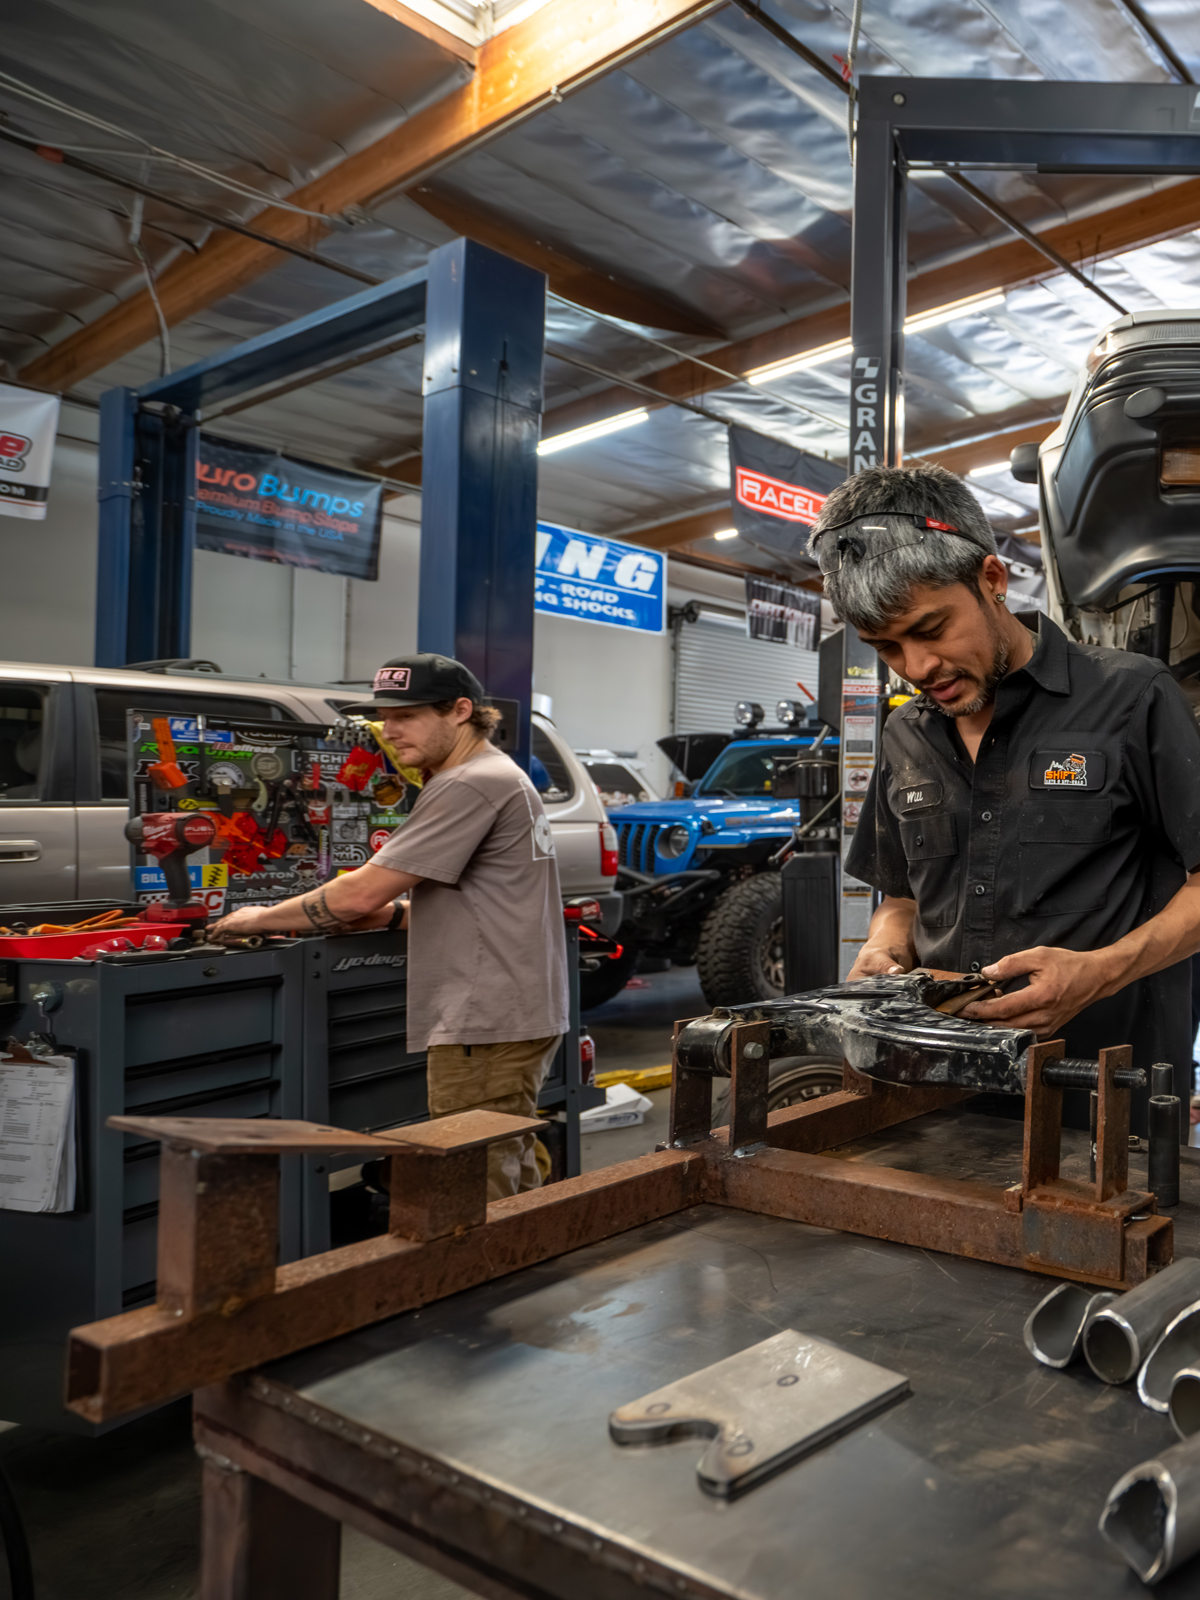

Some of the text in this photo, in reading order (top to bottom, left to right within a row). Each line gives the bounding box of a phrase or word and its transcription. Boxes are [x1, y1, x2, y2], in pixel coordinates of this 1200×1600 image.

[258, 474, 365, 518] Bumps
[247, 512, 282, 528] Made
[284, 521, 296, 532] in
[297, 523, 316, 537] the
[318, 528, 345, 541] USA
[560, 583, 619, 604] ROAD
[561, 596, 637, 621] SHOCKS
[1046, 770, 1077, 780] SHIFT
[907, 791, 923, 804] Will
[232, 872, 295, 880] CLAYTON
